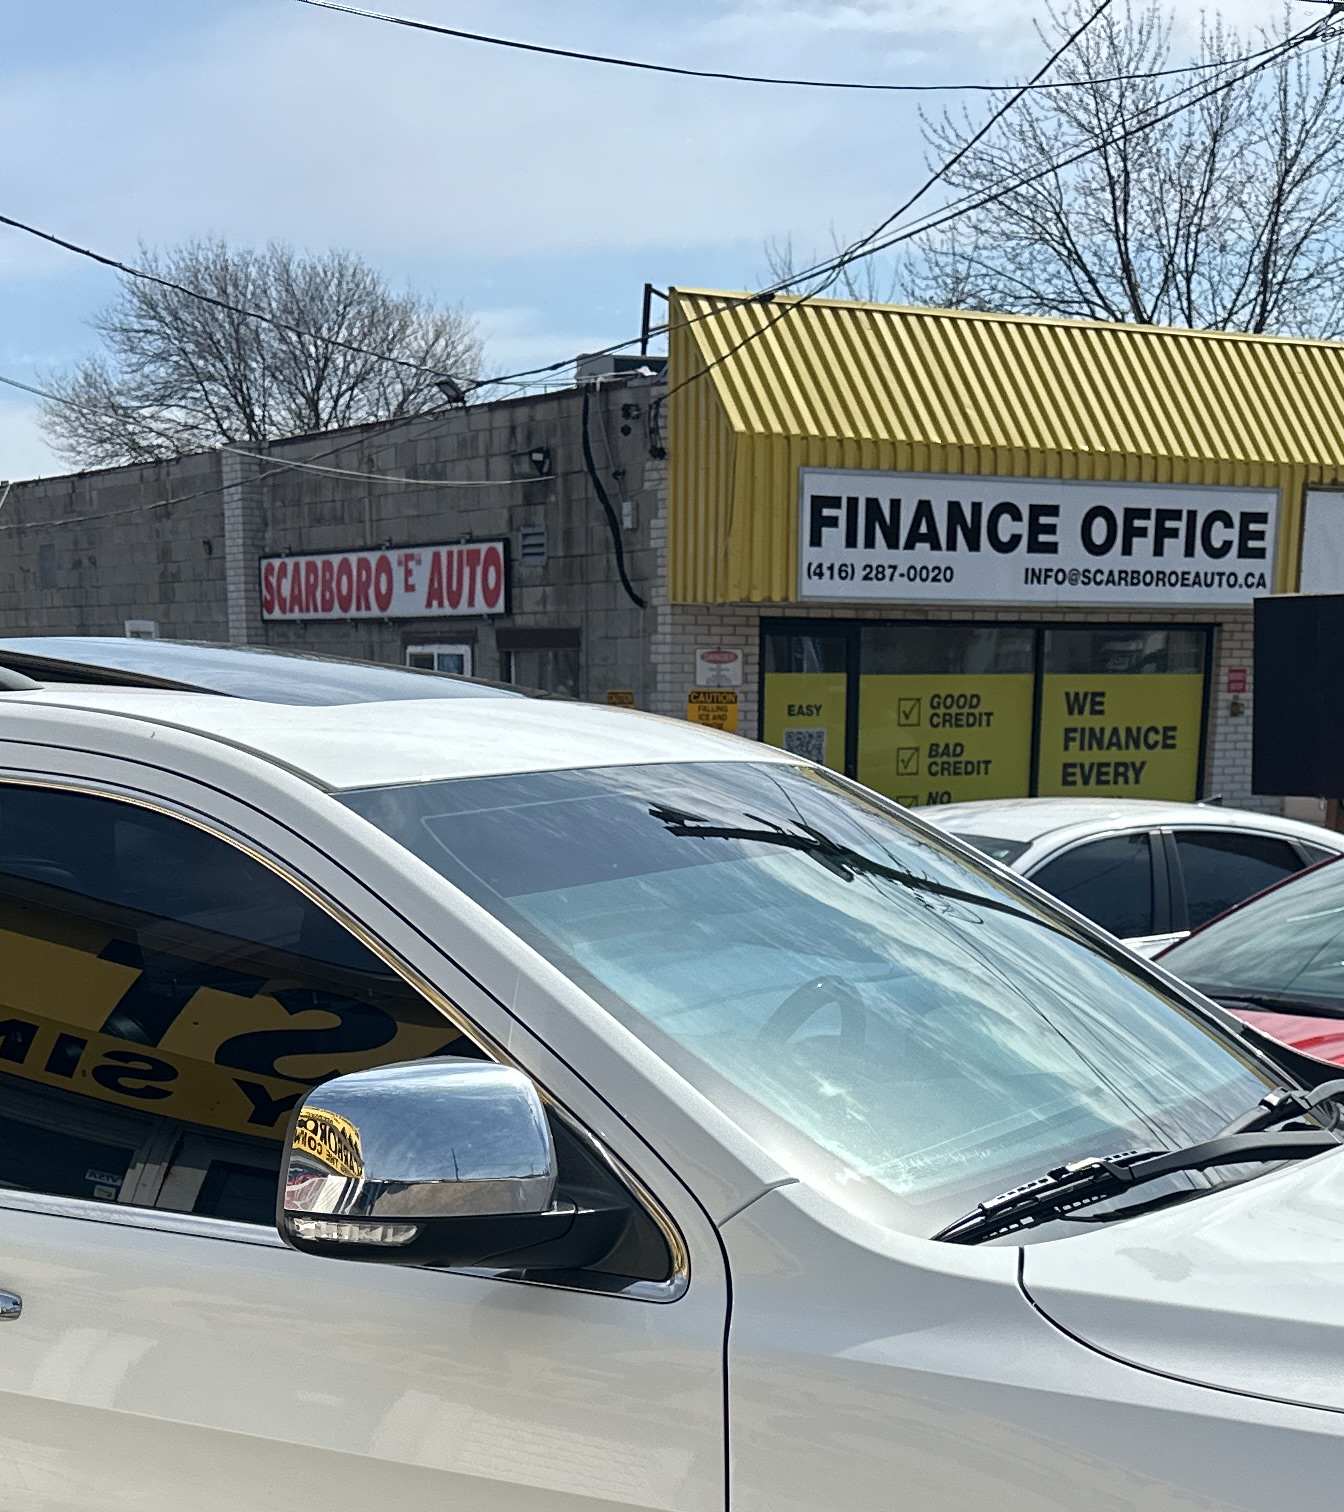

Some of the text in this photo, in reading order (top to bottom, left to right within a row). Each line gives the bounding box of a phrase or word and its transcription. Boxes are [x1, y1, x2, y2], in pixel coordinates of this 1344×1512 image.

[809, 494, 1269, 559] FINANCE OFFICE
[263, 554, 393, 615] SCARBORO
[425, 546, 502, 609] AUTO
[806, 561, 954, 583] (416) 287-0020
[1023, 566, 1267, 589] INFO@SCARBOROEAUTO.CA
[690, 692, 736, 703] CAUTION
[929, 694, 981, 710] GOOD
[1065, 691, 1106, 716] WE
[787, 703, 823, 717] EASY
[929, 711, 994, 728] CREDIT
[1063, 725, 1178, 752] FINANCE
[927, 743, 965, 758] BAD
[927, 760, 992, 777] CREDIT
[1060, 761, 1147, 787] EVERY
[927, 791, 952, 803] NO
